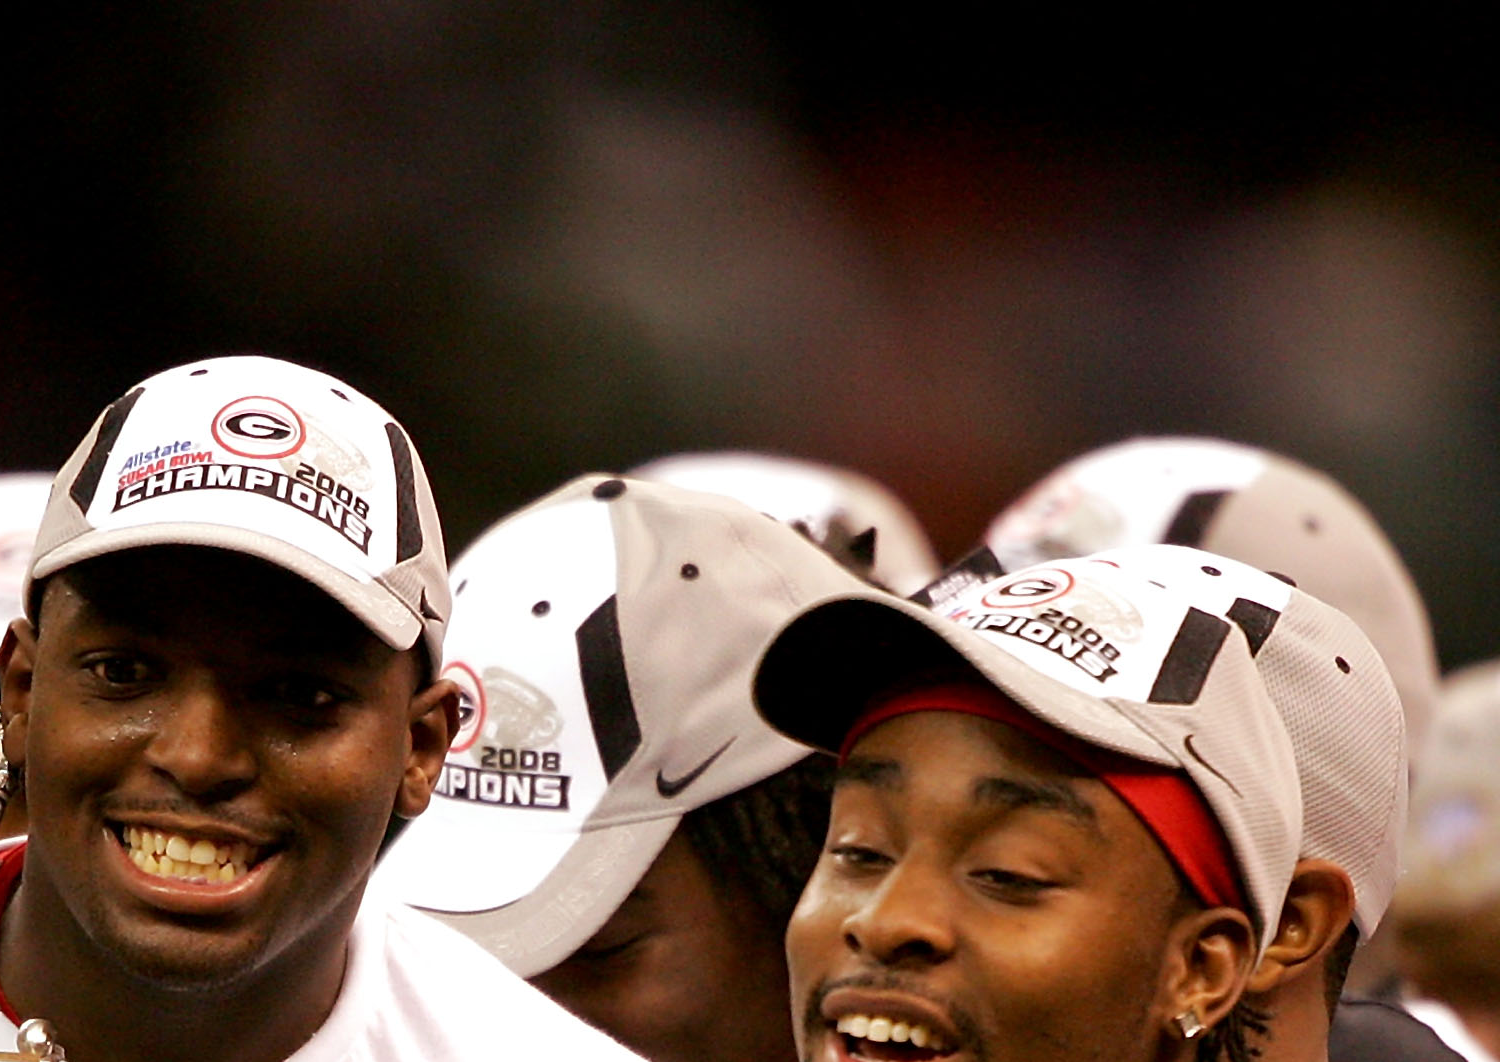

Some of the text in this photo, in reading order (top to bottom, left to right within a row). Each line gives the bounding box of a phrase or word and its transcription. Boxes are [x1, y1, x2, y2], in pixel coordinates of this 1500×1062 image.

[117, 451, 214, 491] SUGAR BOWL
[118, 440, 192, 475] Allstate
[119, 464, 367, 547] CHAMPIONS
[296, 462, 370, 520] 2008
[1038, 608, 1121, 662] 2008
[480, 746, 561, 772] 2008
